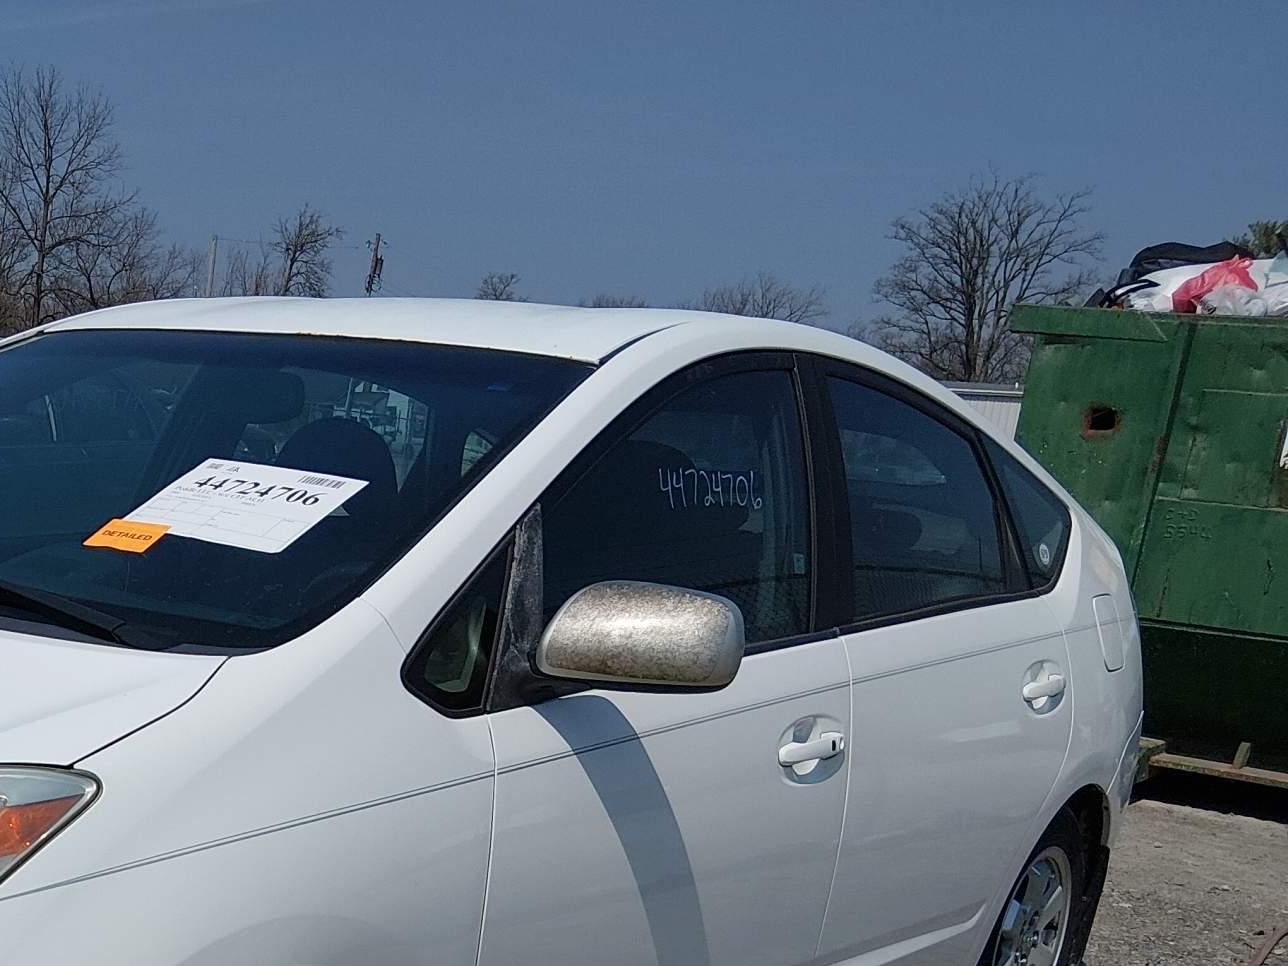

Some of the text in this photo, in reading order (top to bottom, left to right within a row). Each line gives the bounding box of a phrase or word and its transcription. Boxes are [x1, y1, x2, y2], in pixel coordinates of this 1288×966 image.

[194, 475, 328, 506] 44724706
[658, 467, 763, 510] 44724706
[102, 529, 153, 541] DETAILED
